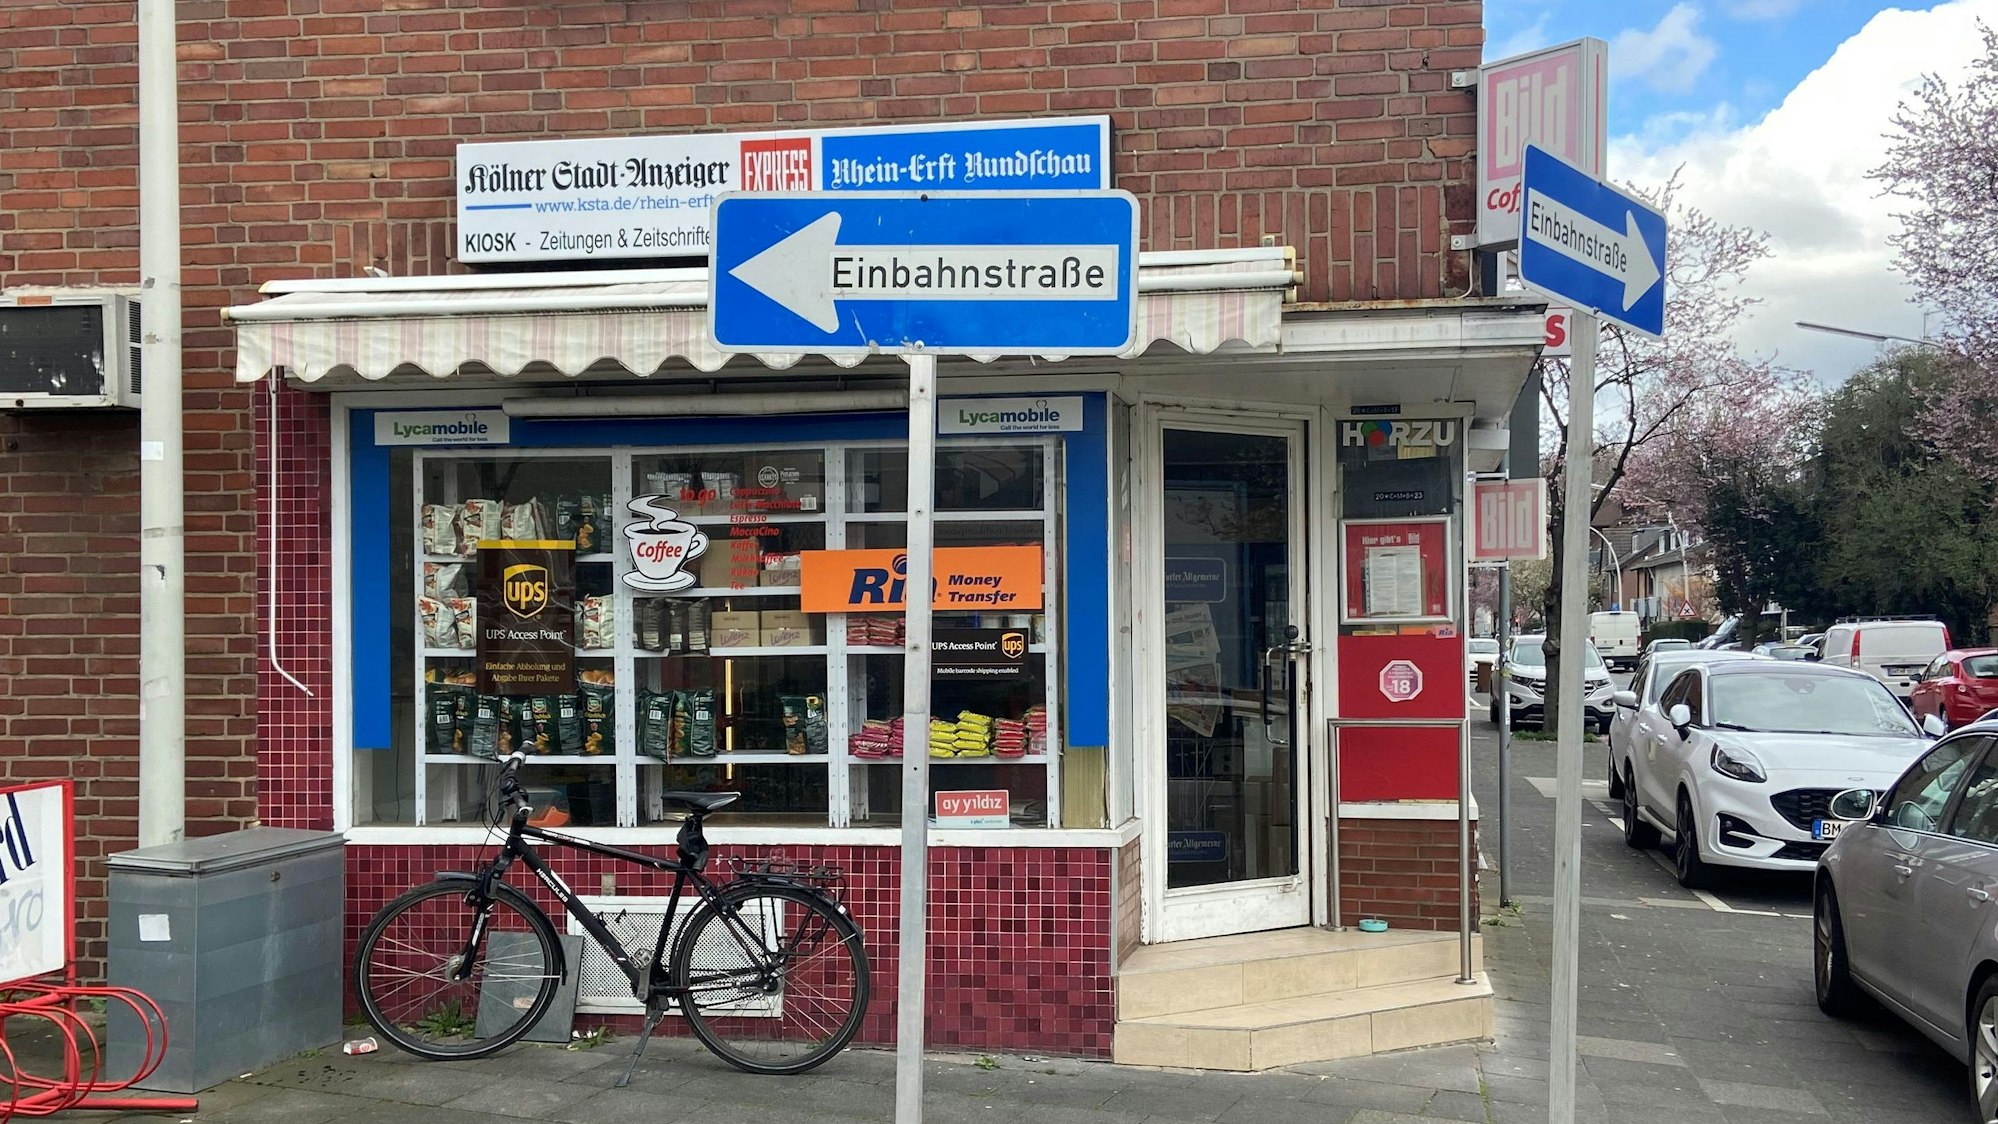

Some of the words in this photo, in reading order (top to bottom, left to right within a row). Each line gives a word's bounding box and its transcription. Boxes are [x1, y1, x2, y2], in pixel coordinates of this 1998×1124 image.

[1496, 66, 1568, 168] Bild
[465, 163, 547, 193] Kölner
[552, 156, 730, 190] Stadt-Anzeiger
[745, 149, 808, 190] EXPRESS
[832, 153, 956, 188] Rhein-Erft
[1487, 182, 1521, 213] Cof
[465, 232, 516, 252] KIOSK
[540, 231, 612, 254] Zeitungen
[618, 229, 628, 248] &
[1531, 201, 1627, 273] Einbahnstraße
[833, 256, 1105, 289] Einbahnstraße
[959, 408, 1060, 426] Lycamobile
[394, 421, 488, 438] Lycamobile
[680, 487, 694, 502] to
[698, 489, 716, 507] go
[730, 514, 767, 525] Espresso
[1481, 491, 1533, 549] Bild
[729, 526, 780, 537] MoccaCino
[730, 540, 758, 551] Kaffee
[1362, 536, 1378, 544] Hier
[1379, 535, 1401, 545] gibt's
[637, 541, 683, 563] Coffee
[731, 582, 745, 590] Tee
[948, 575, 1002, 588] Money
[507, 581, 545, 610] ups
[948, 591, 1016, 604] Transfer
[486, 630, 506, 639] UPS
[507, 630, 538, 640] Access
[931, 641, 948, 650] UPS
[948, 641, 973, 650] Access
[1004, 640, 1022, 654] ups
[485, 662, 515, 671] Einfache
[516, 662, 550, 672] Abholung
[551, 662, 566, 671] und
[976, 667, 998, 675] shipping
[492, 674, 517, 683] Abgabe
[518, 674, 535, 682] Ihrer
[536, 674, 560, 682] Pakete
[1391, 679, 1411, 694] 18
[942, 798, 960, 814] ay
[1822, 822, 1841, 836] BM
